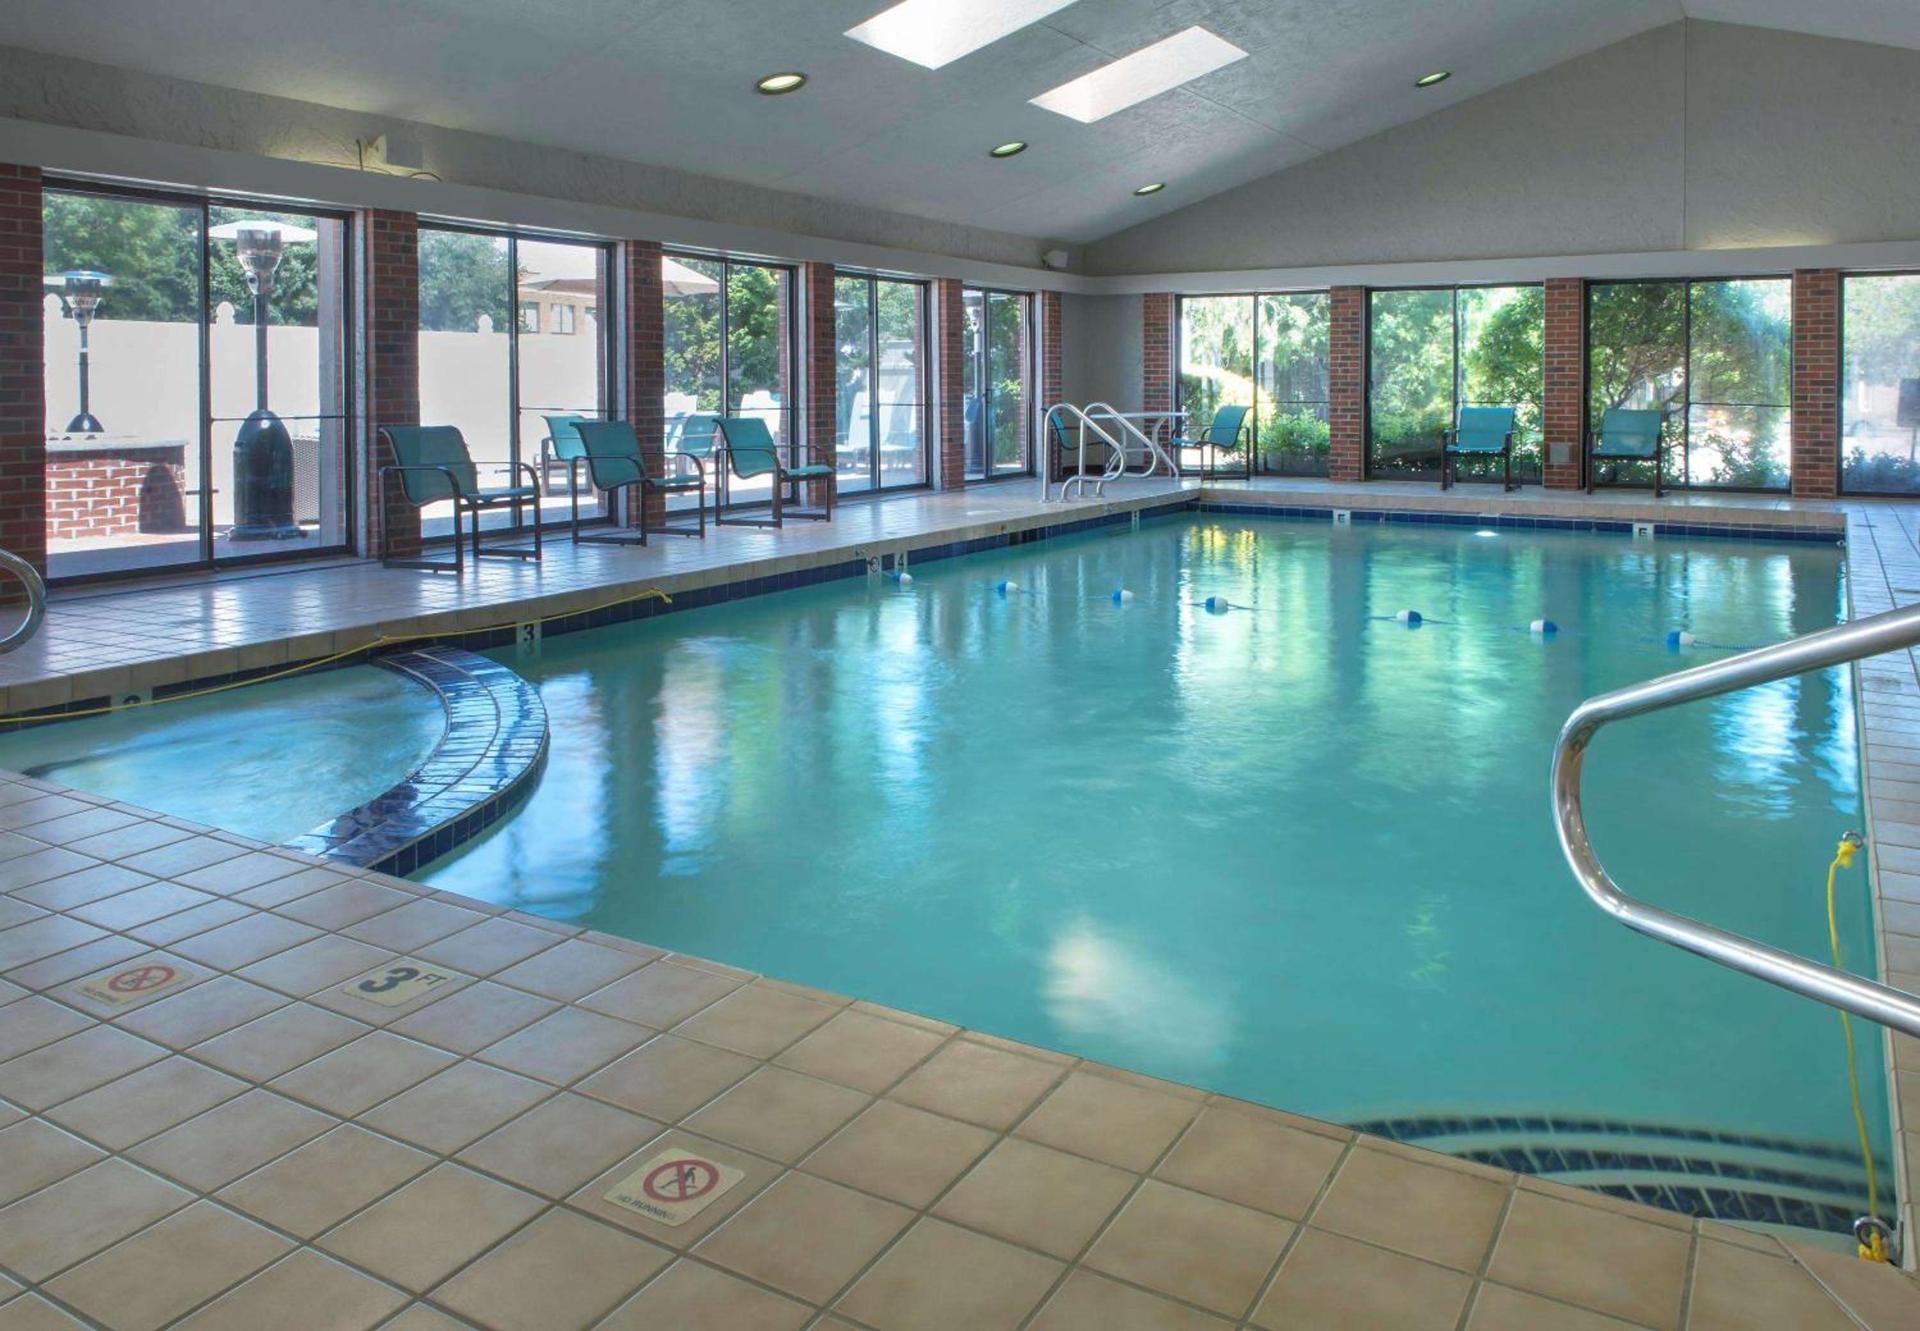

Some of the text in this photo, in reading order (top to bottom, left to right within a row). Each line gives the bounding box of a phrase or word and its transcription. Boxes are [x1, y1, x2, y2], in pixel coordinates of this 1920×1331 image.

[523, 623, 535, 642] 3
[358, 967, 448, 993] 3 FT
